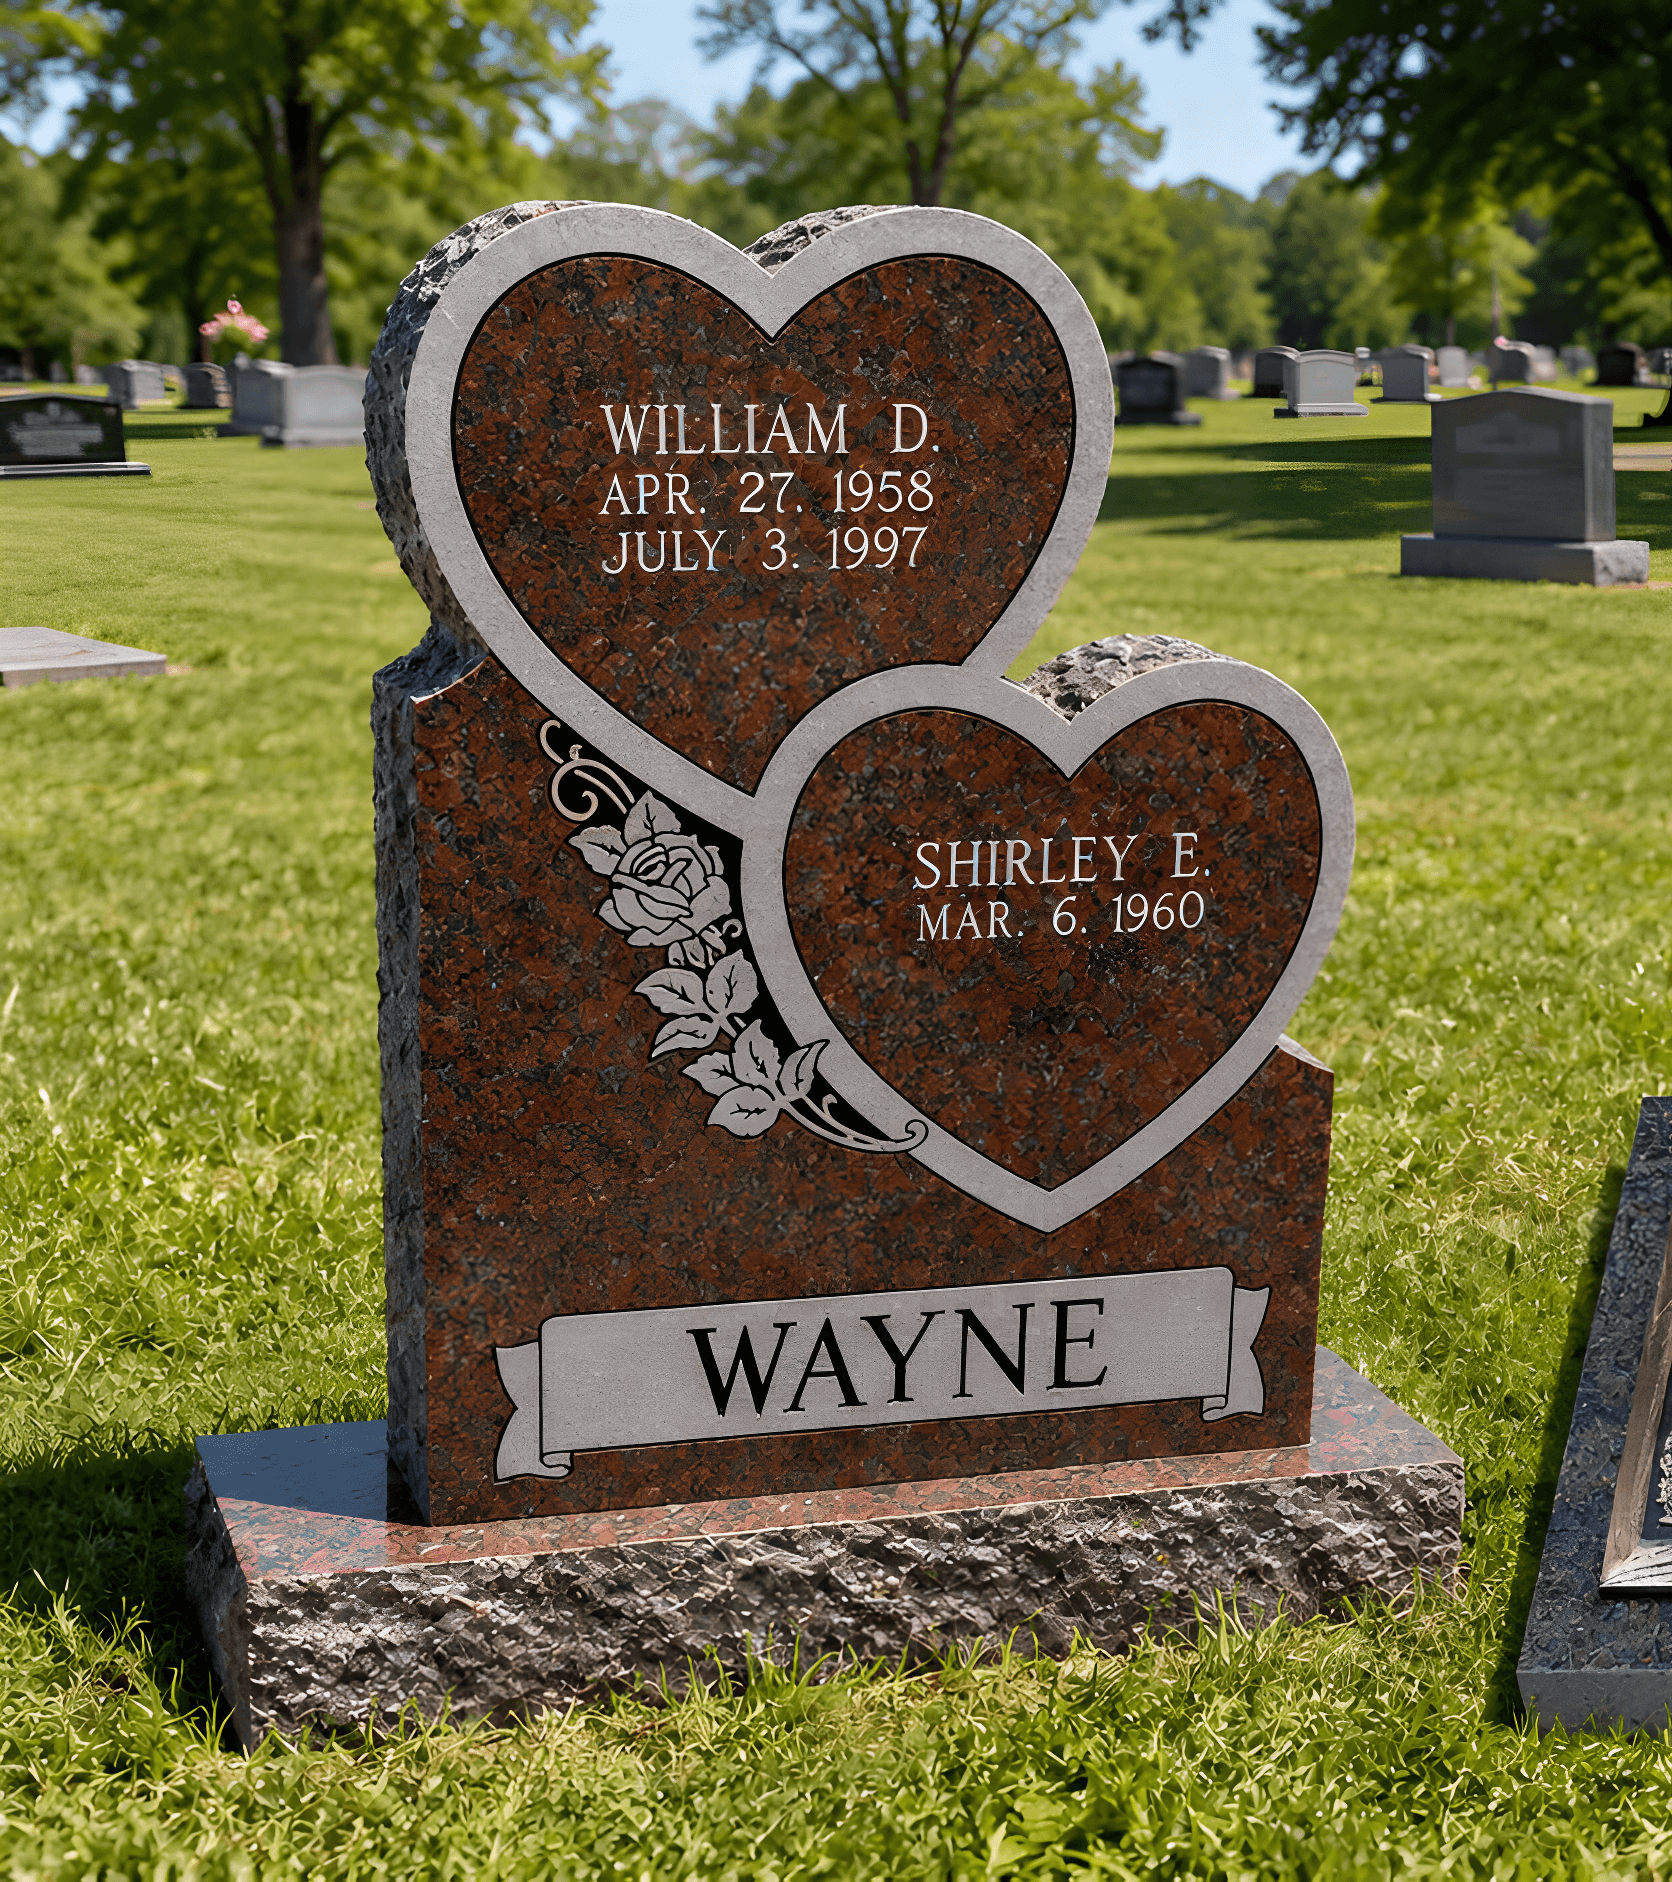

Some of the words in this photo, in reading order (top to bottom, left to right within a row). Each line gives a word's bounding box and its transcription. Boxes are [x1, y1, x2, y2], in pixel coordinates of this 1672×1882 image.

[600, 403, 850, 455] WILLIAM
[889, 403, 941, 453] D.
[598, 471, 706, 516] APR.
[832, 469, 934, 513] 1958
[601, 529, 727, 573] JULY
[828, 526, 929, 569] 1997
[913, 835, 1138, 889] SHIRLEY
[1170, 832, 1211, 878] E.
[916, 901, 1024, 942] MAR.
[1112, 891, 1205, 933] 1960
[686, 1297, 1108, 1418] WAYNE
